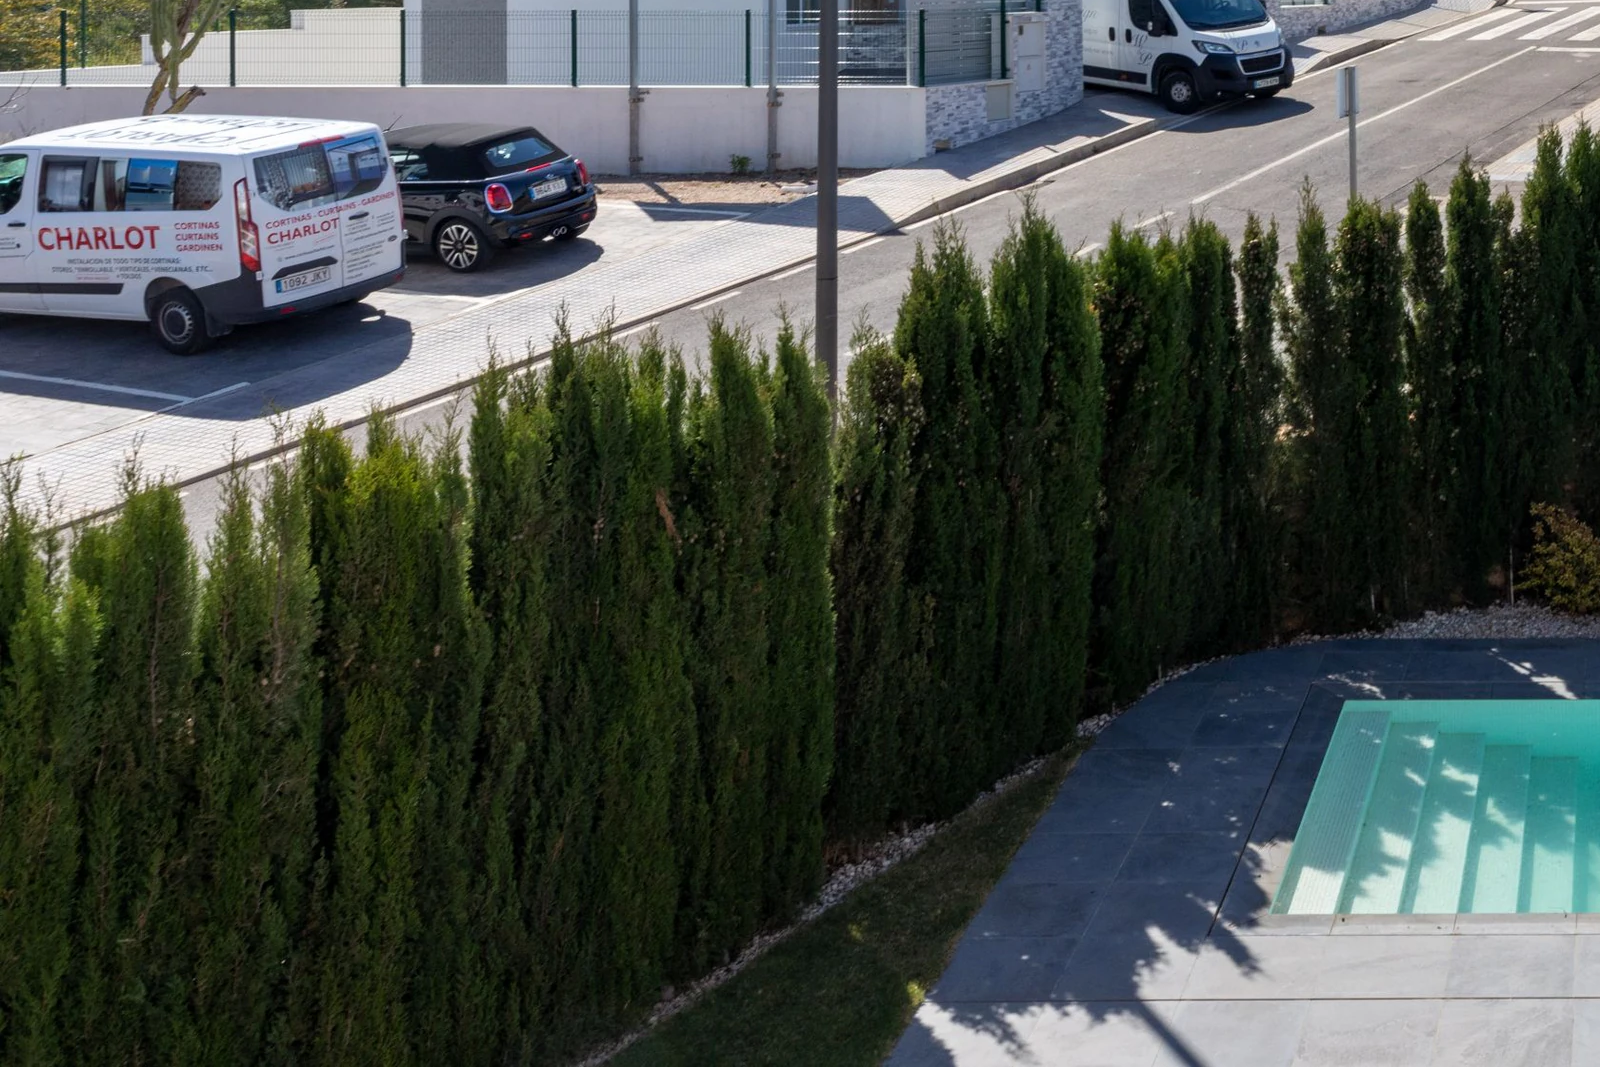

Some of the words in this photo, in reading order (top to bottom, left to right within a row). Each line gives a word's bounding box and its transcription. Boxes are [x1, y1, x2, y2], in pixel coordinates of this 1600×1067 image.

[265, 213, 312, 229] CORTINAS
[318, 201, 356, 217] CURTAINS
[174, 221, 220, 230] CORTINAS
[267, 217, 340, 244] CHARLOT
[38, 226, 160, 250] CHARLOT
[175, 233, 220, 241] CURTAINS
[176, 243, 223, 252] GARDINEN
[283, 275, 308, 289] 1092
